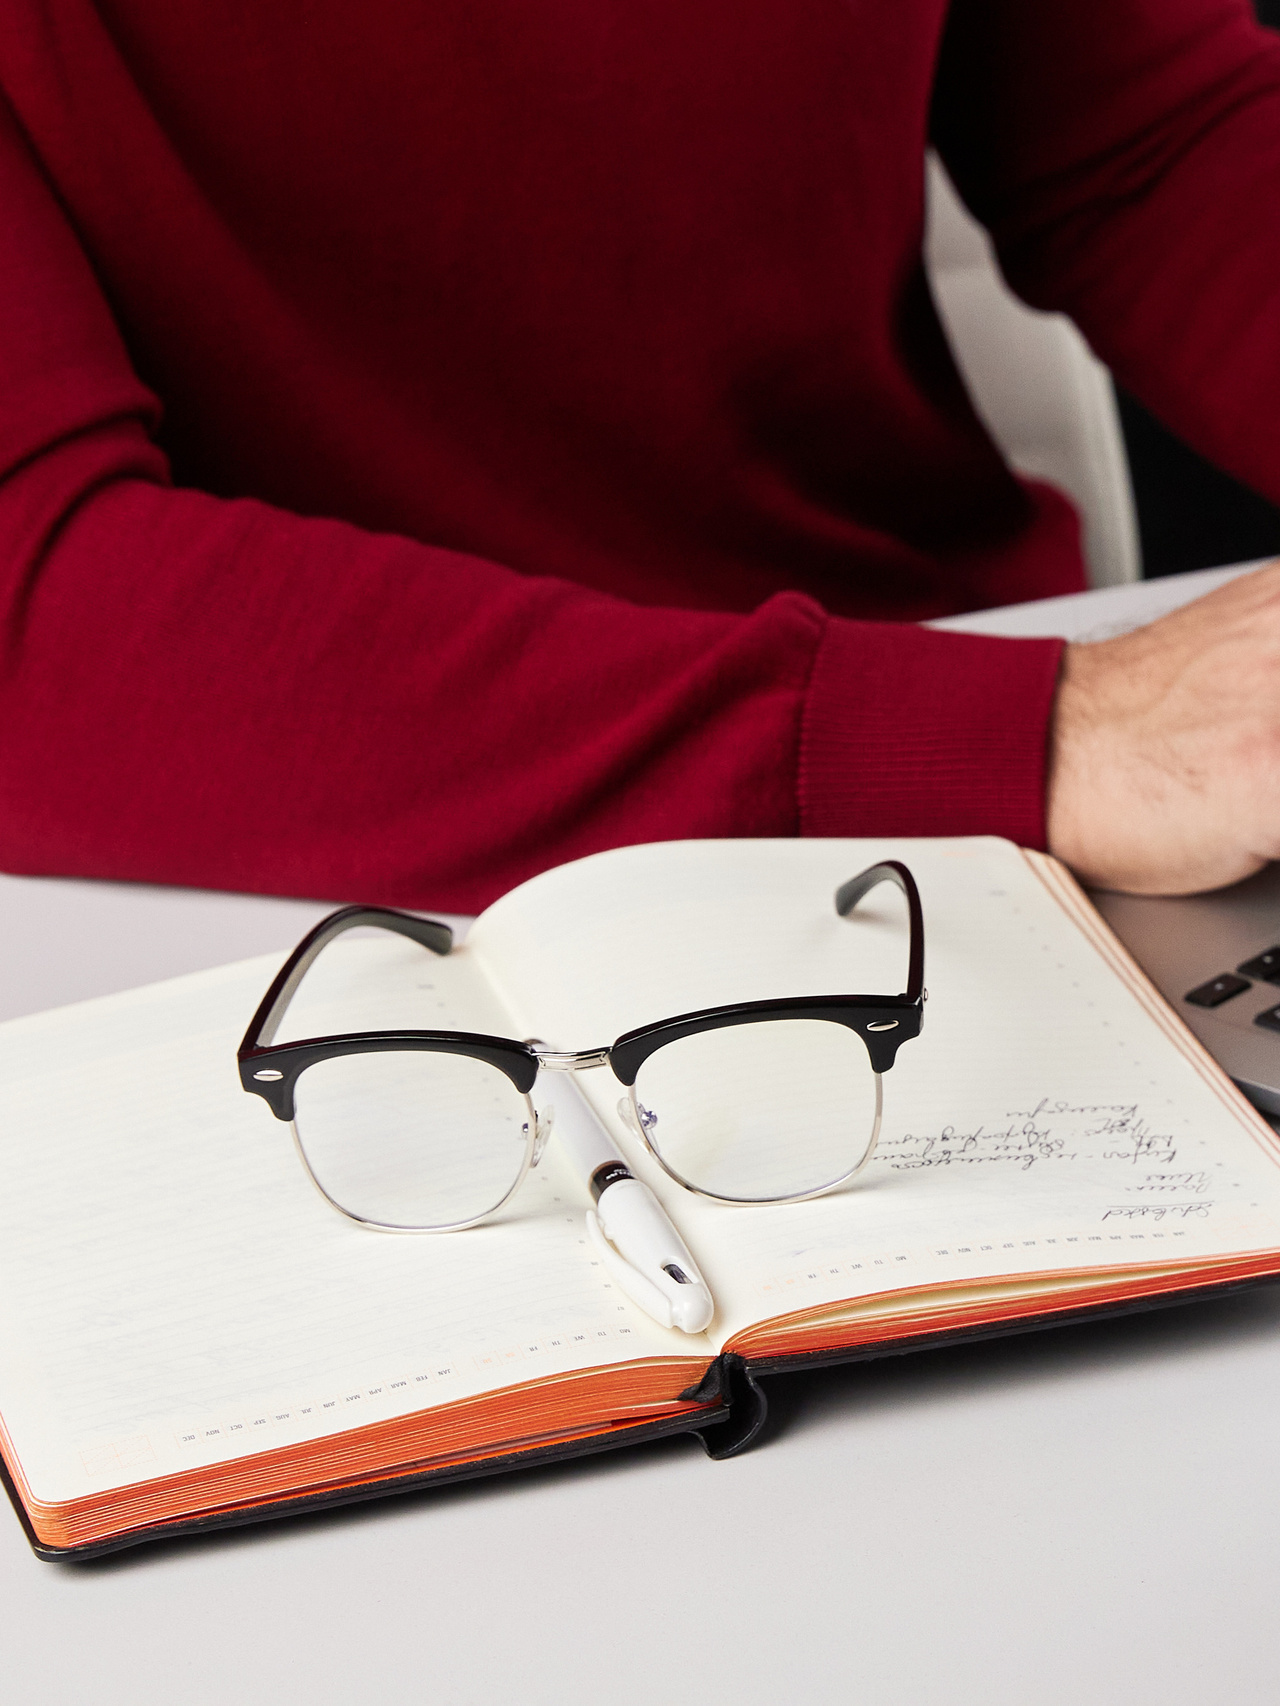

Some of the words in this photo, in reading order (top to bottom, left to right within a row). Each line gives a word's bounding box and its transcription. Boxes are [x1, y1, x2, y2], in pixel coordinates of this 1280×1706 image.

[437, 1368, 451, 1376] JAN
[415, 1374, 428, 1382] FEB
[390, 1381, 407, 1389] MAR
[368, 1387, 382, 1396] APR
[345, 1394, 361, 1402] MAY
[322, 1401, 336, 1409] JUN
[301, 1407, 312, 1415] JUL
[275, 1413, 290, 1421] AUG
[253, 1418, 267, 1426] SEP
[230, 1423, 243, 1431] OCT
[205, 1429, 221, 1437] NOV
[182, 1434, 196, 1442] DEC
